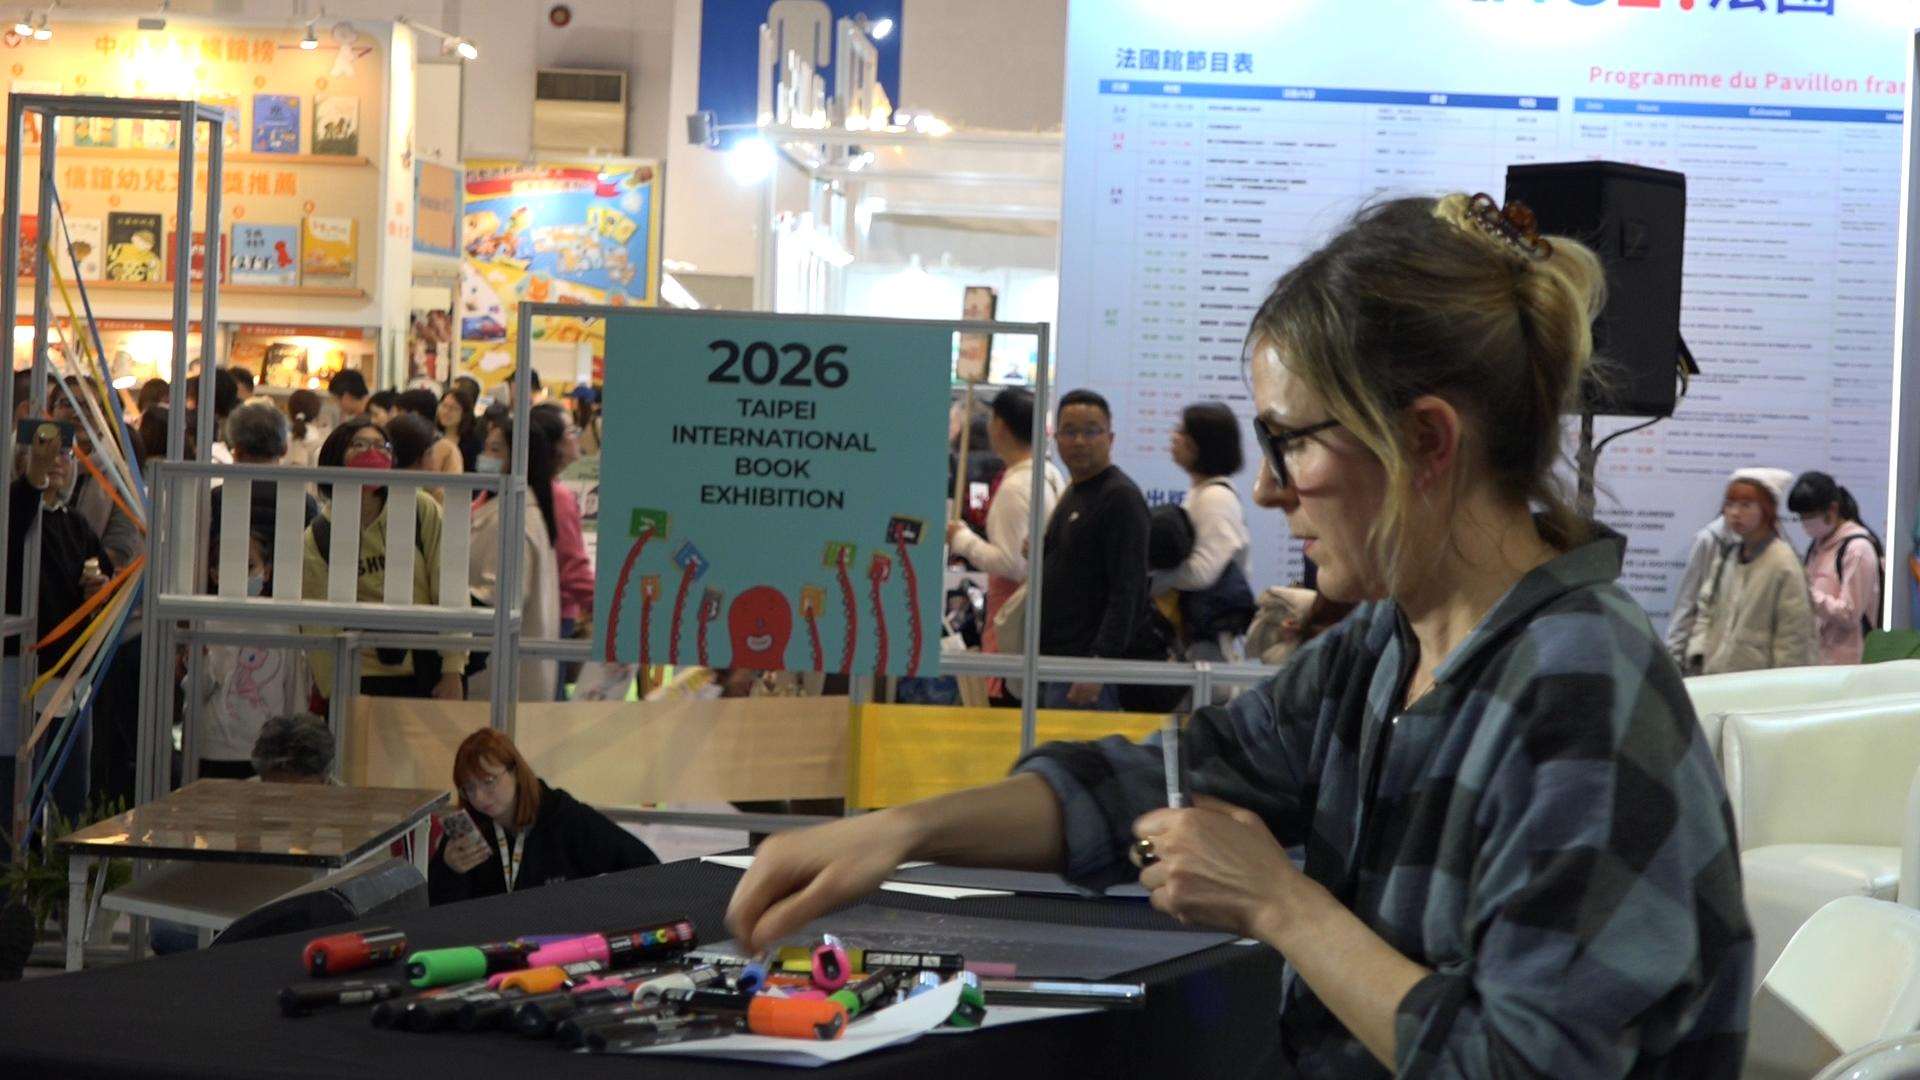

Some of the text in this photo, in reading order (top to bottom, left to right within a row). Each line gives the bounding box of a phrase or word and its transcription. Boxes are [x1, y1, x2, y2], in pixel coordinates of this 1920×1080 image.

[1116, 48, 1253, 73] 法國館節目表
[1589, 66, 1721, 90] Programme
[1729, 71, 1757, 89] du
[1765, 73, 1858, 92] Pavillon
[707, 338, 849, 388] 2026
[737, 398, 816, 420] TAIPEI
[672, 425, 877, 452] INTERNATIONAL
[735, 457, 811, 478] BOOK
[701, 485, 844, 509] EXHIBITION
